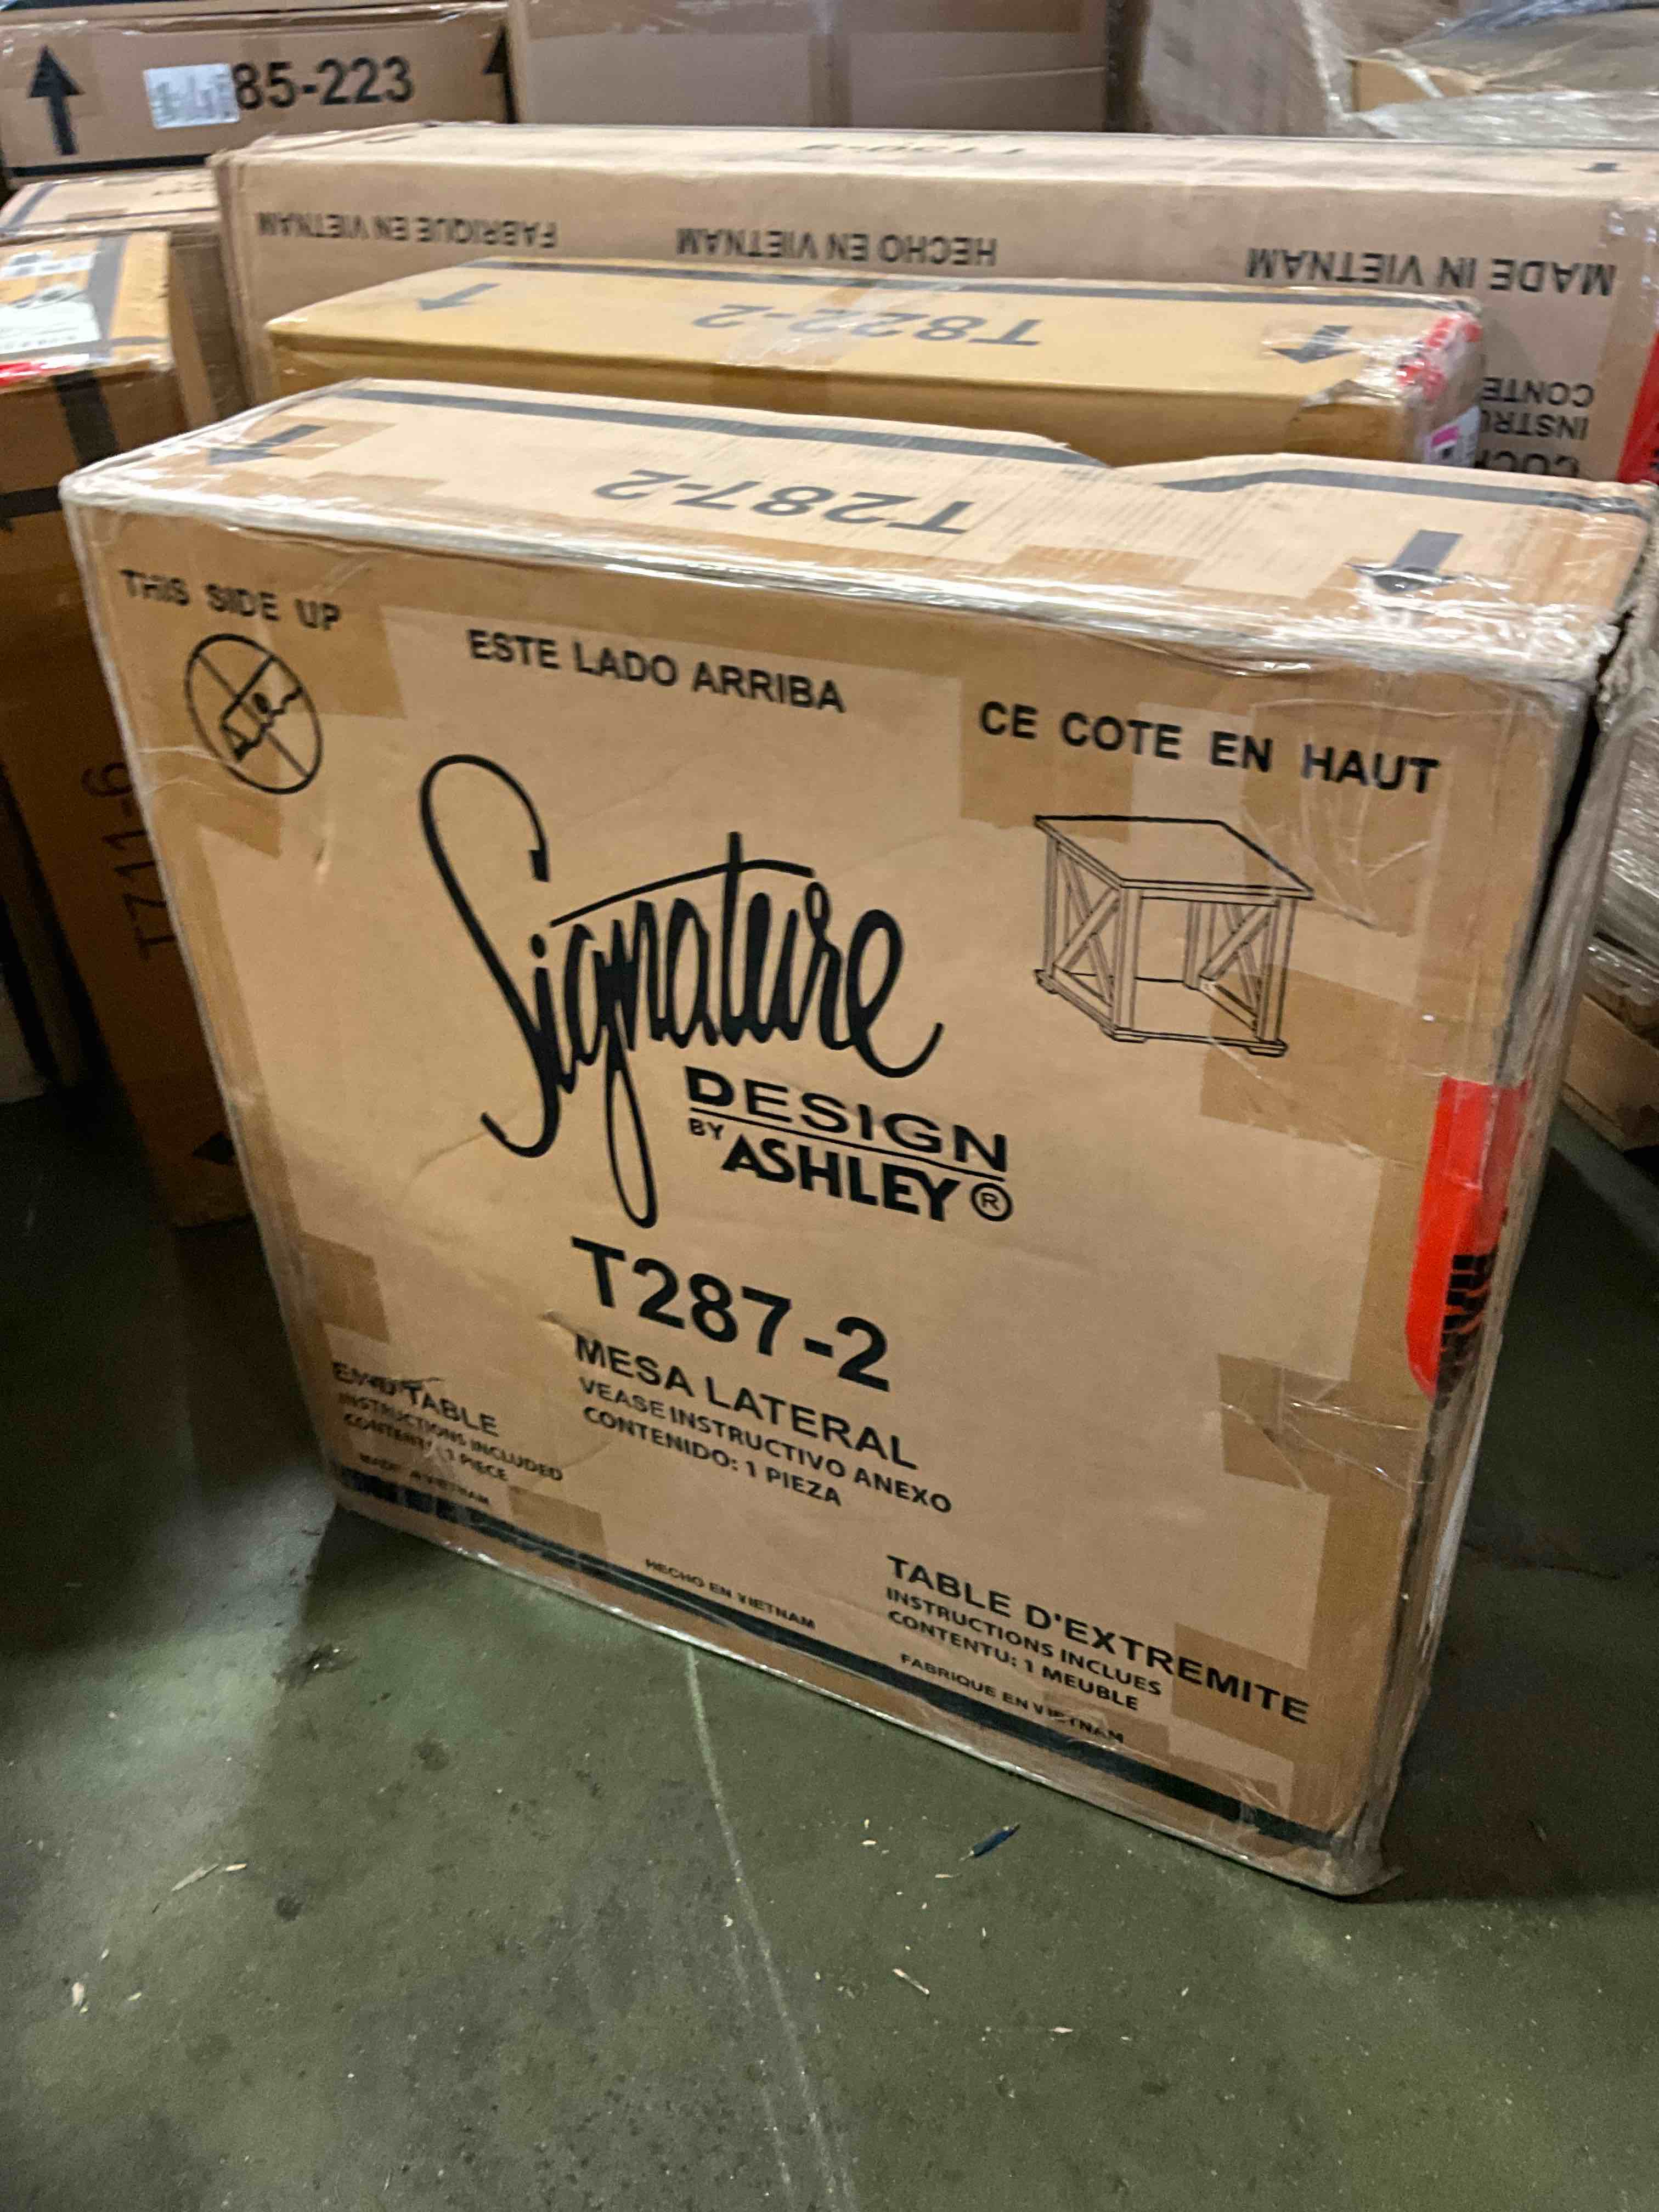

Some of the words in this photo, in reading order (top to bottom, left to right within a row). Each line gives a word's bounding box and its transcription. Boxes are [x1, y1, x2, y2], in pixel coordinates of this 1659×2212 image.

[233, 56, 414, 110] 85-223
[258, 211, 368, 240] VIETNAM
[372, 215, 405, 241] EN
[417, 217, 557, 248] FABRIQUE
[676, 227, 817, 259] VIETNAM
[827, 230, 869, 262] EN
[878, 233, 997, 266] HECHO
[1245, 247, 1424, 286] VIETNAM
[1438, 256, 1477, 289] IN
[1490, 258, 1617, 296] MADE
[693, 303, 1042, 347] T822-2
[592, 469, 974, 535] T287-2
[119, 569, 189, 605] THIS
[205, 582, 281, 622] SIDE
[294, 598, 341, 631] UP
[468, 629, 561, 669] ESTE
[573, 641, 679, 687] LADO
[691, 662, 847, 713] ARRIBA
[979, 701, 1038, 740] CE
[1060, 712, 1182, 760] COTE
[1210, 730, 1273, 773] EN
[1302, 742, 1441, 794] HAUT
[419, 754, 944, 1228] Signature
[684, 1065, 1007, 1172] DESIGN
[688, 1118, 724, 1141] BY
[571, 1236, 890, 1392] T287-2
[403, 1378, 500, 1437] TABLE
[575, 1334, 695, 1398] MESA
[706, 1375, 918, 1471] LATERAL
[471, 1438, 563, 1481] INCLUDED
[579, 1375, 666, 1420] VEASE
[670, 1406, 846, 1479] INSTRUCTIVO
[853, 1466, 953, 1514] ANEXO
[584, 1406, 739, 1471] CONTENIDO:
[746, 1460, 757, 1478] 1
[766, 1465, 842, 1507] PIEZA
[645, 1558, 706, 1588] HECHO
[709, 1582, 732, 1599] EN
[737, 1592, 816, 1629] VIETNAM
[886, 1554, 1012, 1618] TABLE
[1025, 1603, 1311, 1725] D'EXTREMITE
[886, 1585, 1053, 1658] INSTRUCTIONS
[1061, 1649, 1163, 1696] INCLUES
[888, 1610, 1018, 1668] CONTENTU:
[1024, 1658, 1035, 1673] 1
[1042, 1664, 1139, 1711] MEUBLE
[900, 1652, 997, 1699] FABRIQUE
[1002, 1691, 1029, 1711] EN
